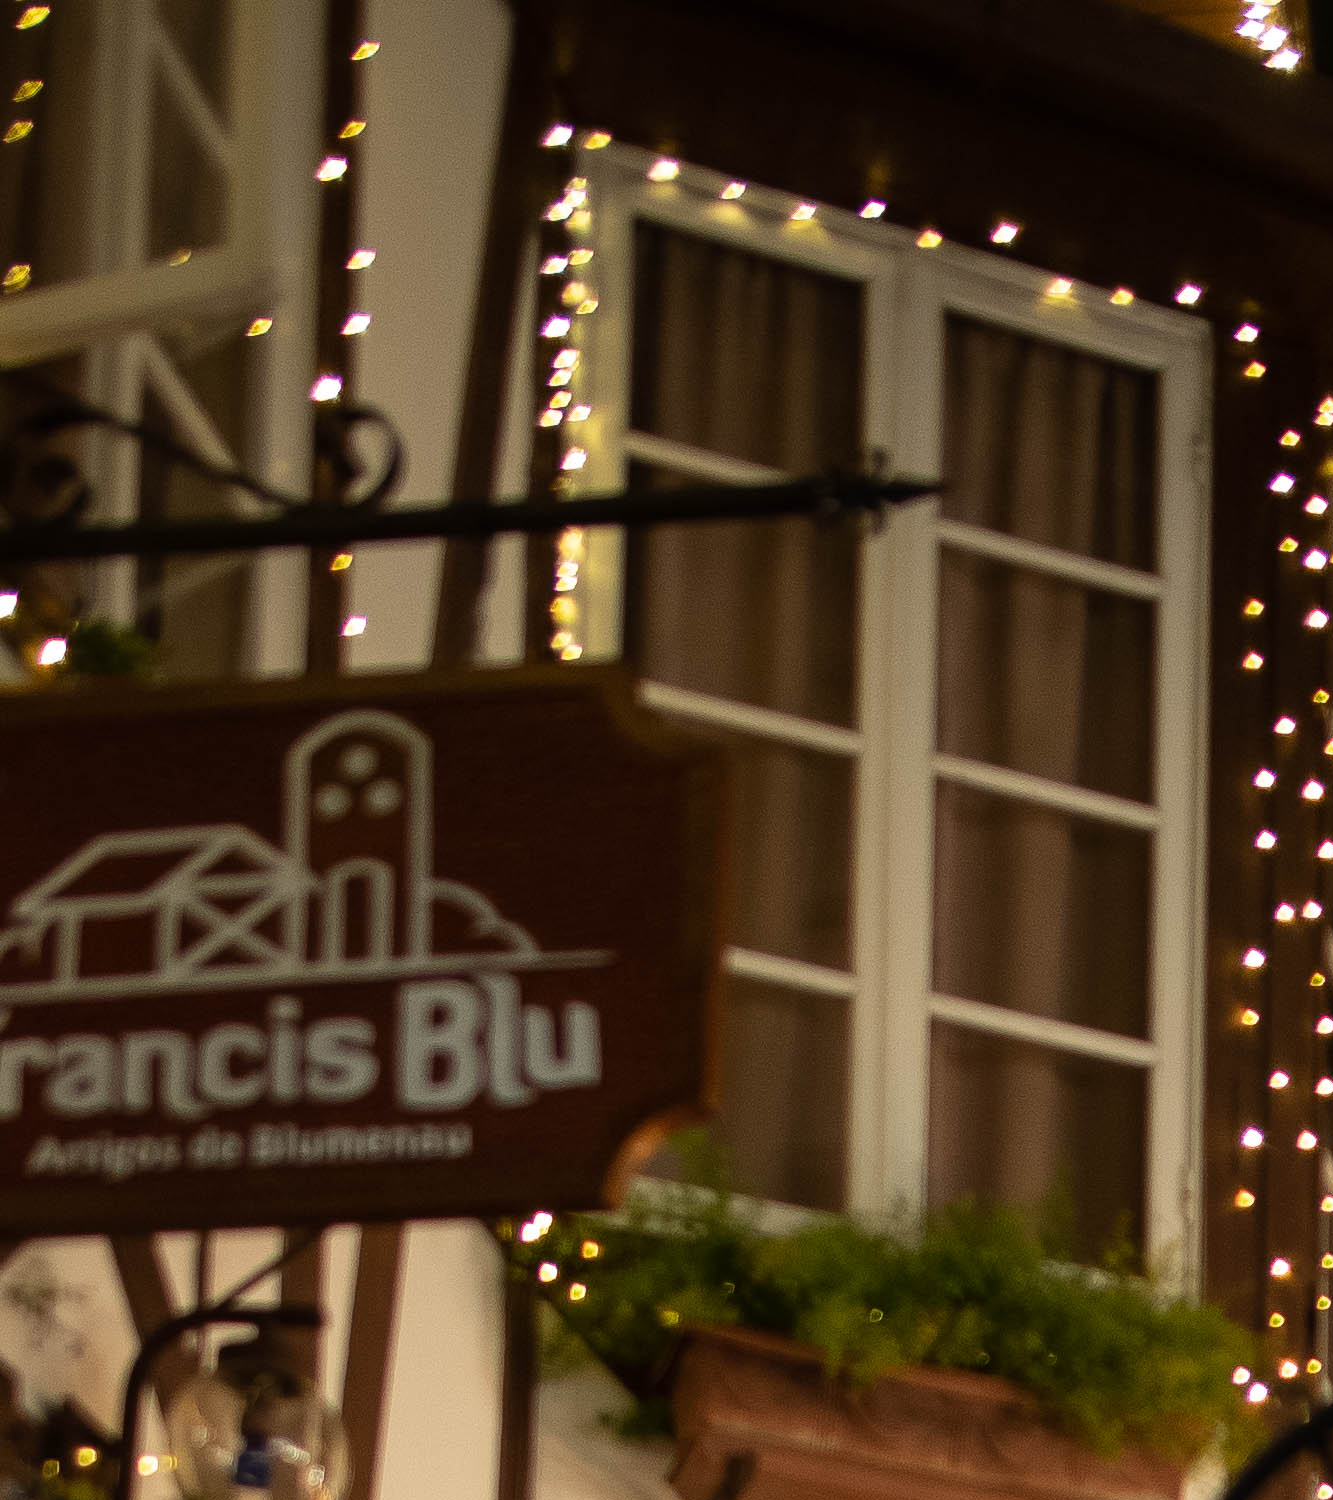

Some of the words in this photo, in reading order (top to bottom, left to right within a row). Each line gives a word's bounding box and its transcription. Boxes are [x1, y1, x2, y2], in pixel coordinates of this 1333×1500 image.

[0, 995, 380, 1118] rancis
[400, 972, 601, 1112] Blu
[25, 1134, 182, 1181] Artigos
[188, 1124, 243, 1169] de
[249, 1121, 474, 1166] Blumenau
